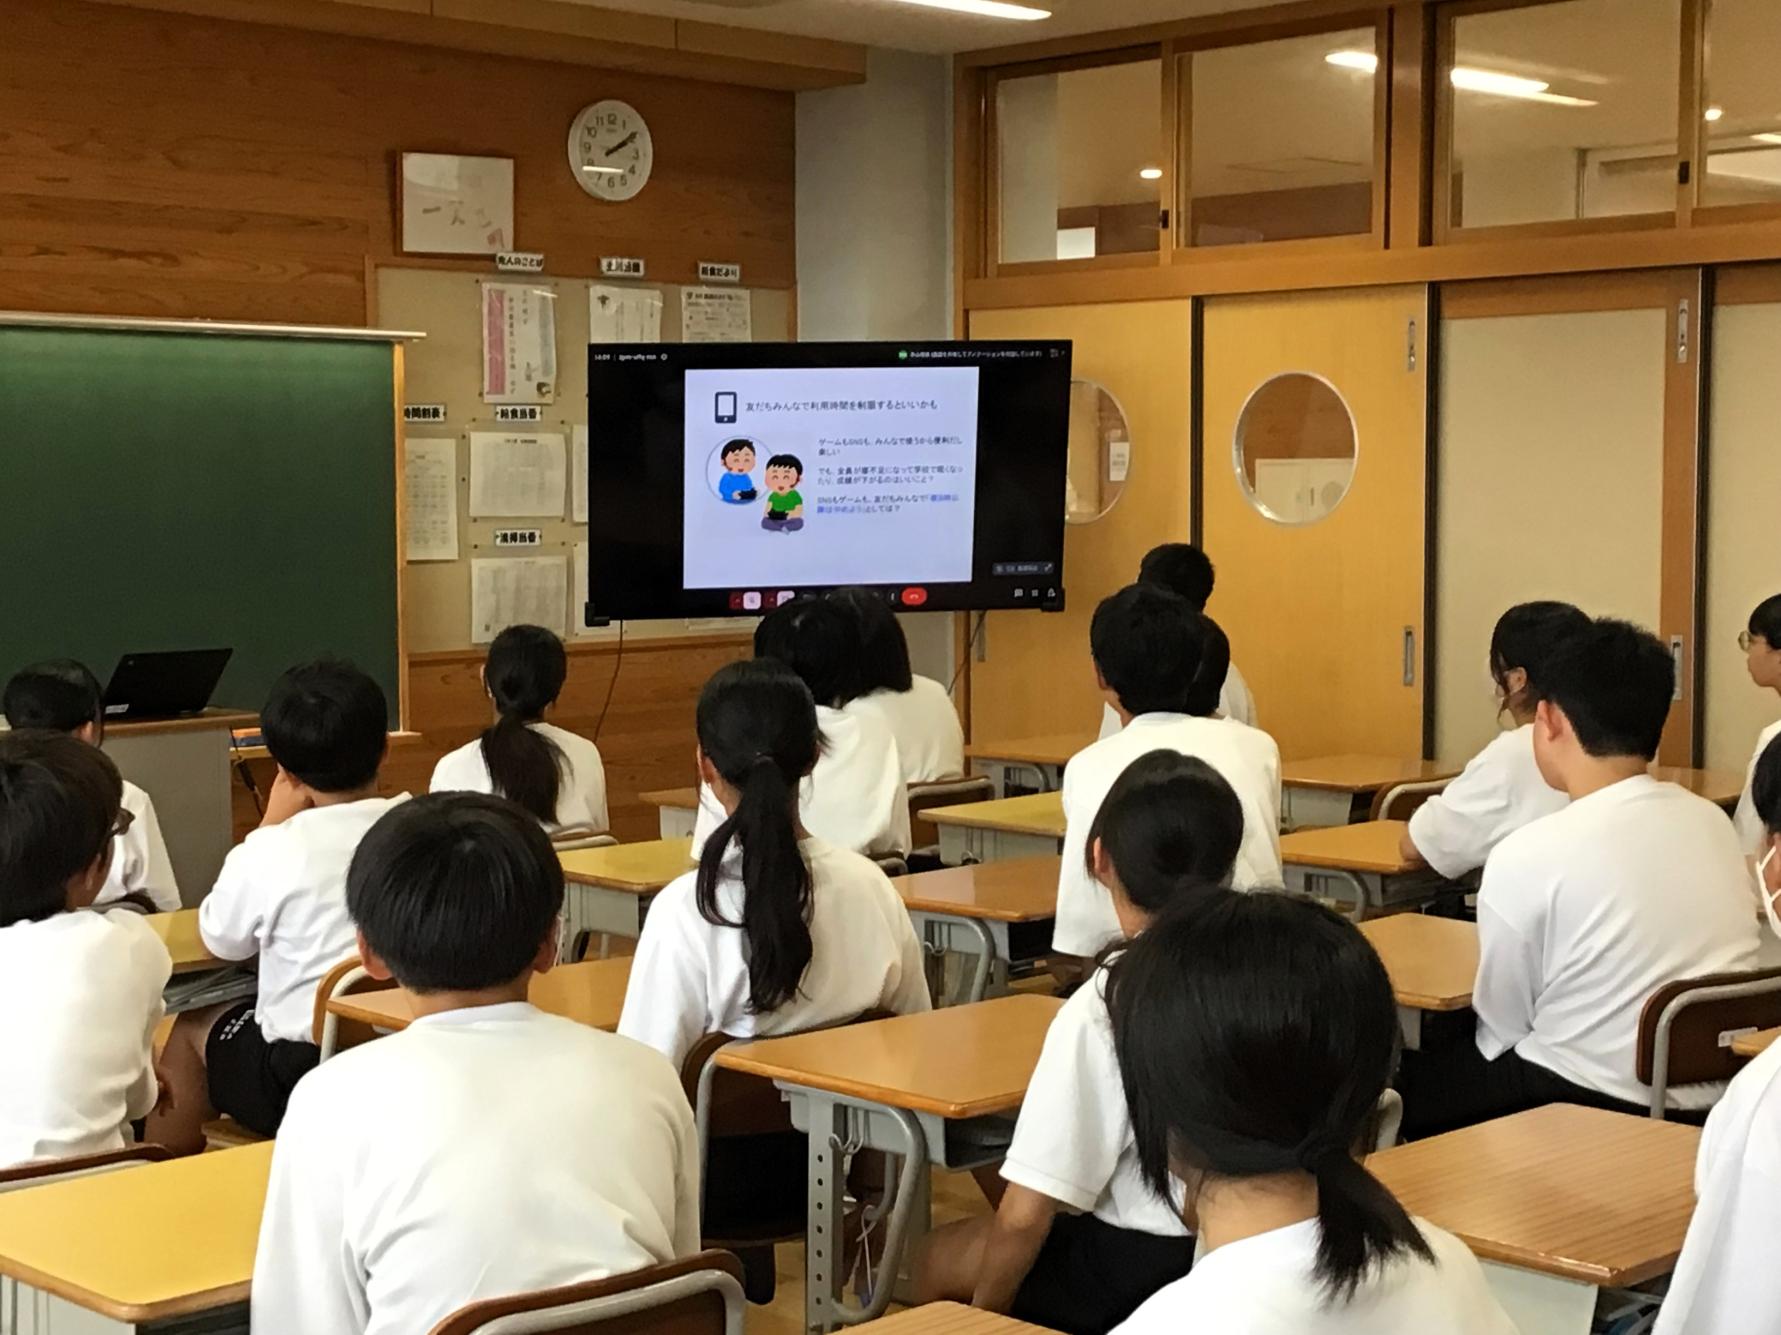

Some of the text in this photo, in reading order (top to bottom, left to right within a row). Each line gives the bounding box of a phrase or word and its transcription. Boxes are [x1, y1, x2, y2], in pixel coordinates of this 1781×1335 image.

[596, 116, 604, 126] 11
[607, 113, 617, 125] 12
[585, 126, 597, 138] 10
[583, 141, 591, 153] 9
[628, 164, 636, 175] 4
[607, 176, 615, 188] 6
[620, 174, 627, 186] 5
[500, 407, 537, 419] 給食当番
[500, 531, 537, 543] 清掃当番
